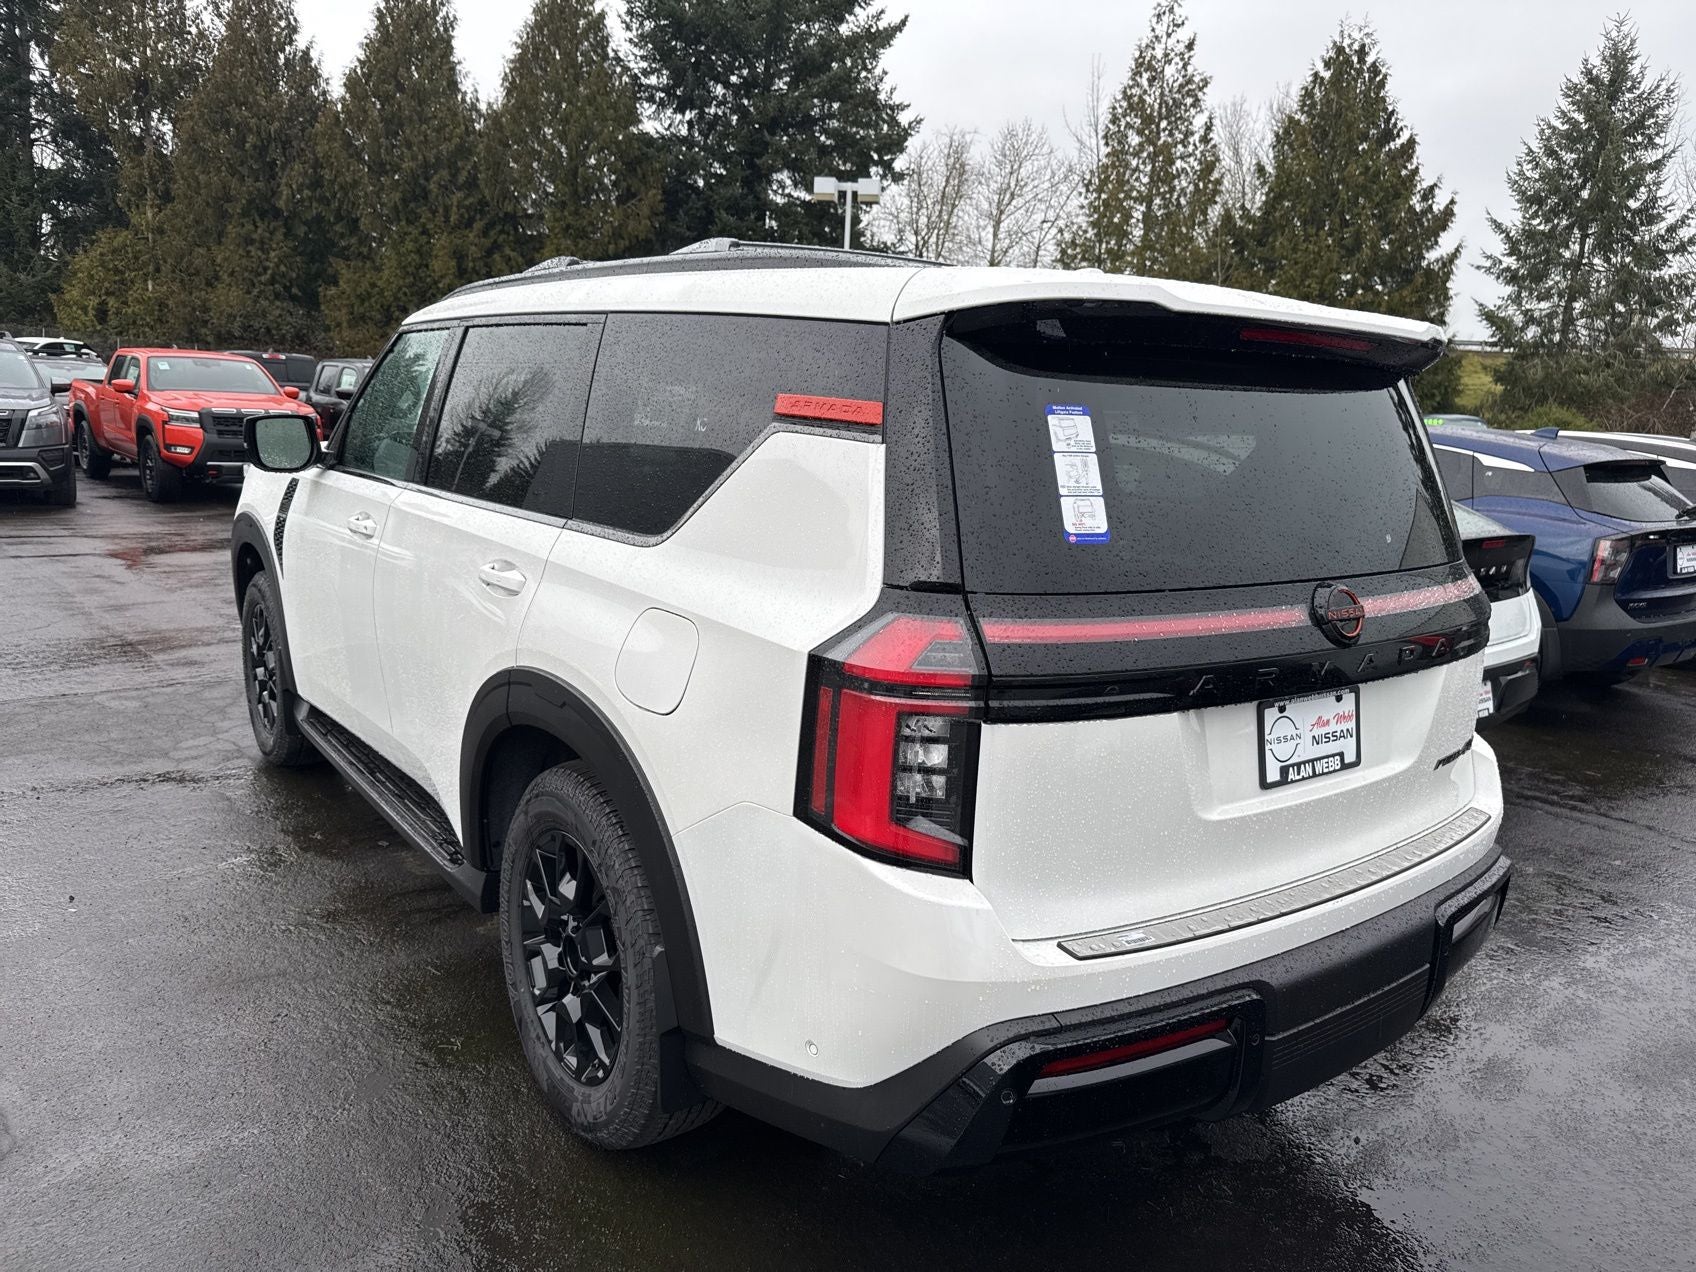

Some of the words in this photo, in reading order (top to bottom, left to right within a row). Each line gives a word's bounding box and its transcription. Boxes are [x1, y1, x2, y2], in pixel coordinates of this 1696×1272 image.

[1309, 716, 1331, 732] Alan
[1333, 709, 1354, 726] Webb
[1266, 732, 1302, 747] NISSAN
[1311, 727, 1354, 747] NISSAN
[1288, 763, 1313, 782] ALAN
[1314, 755, 1341, 775] WEBB
